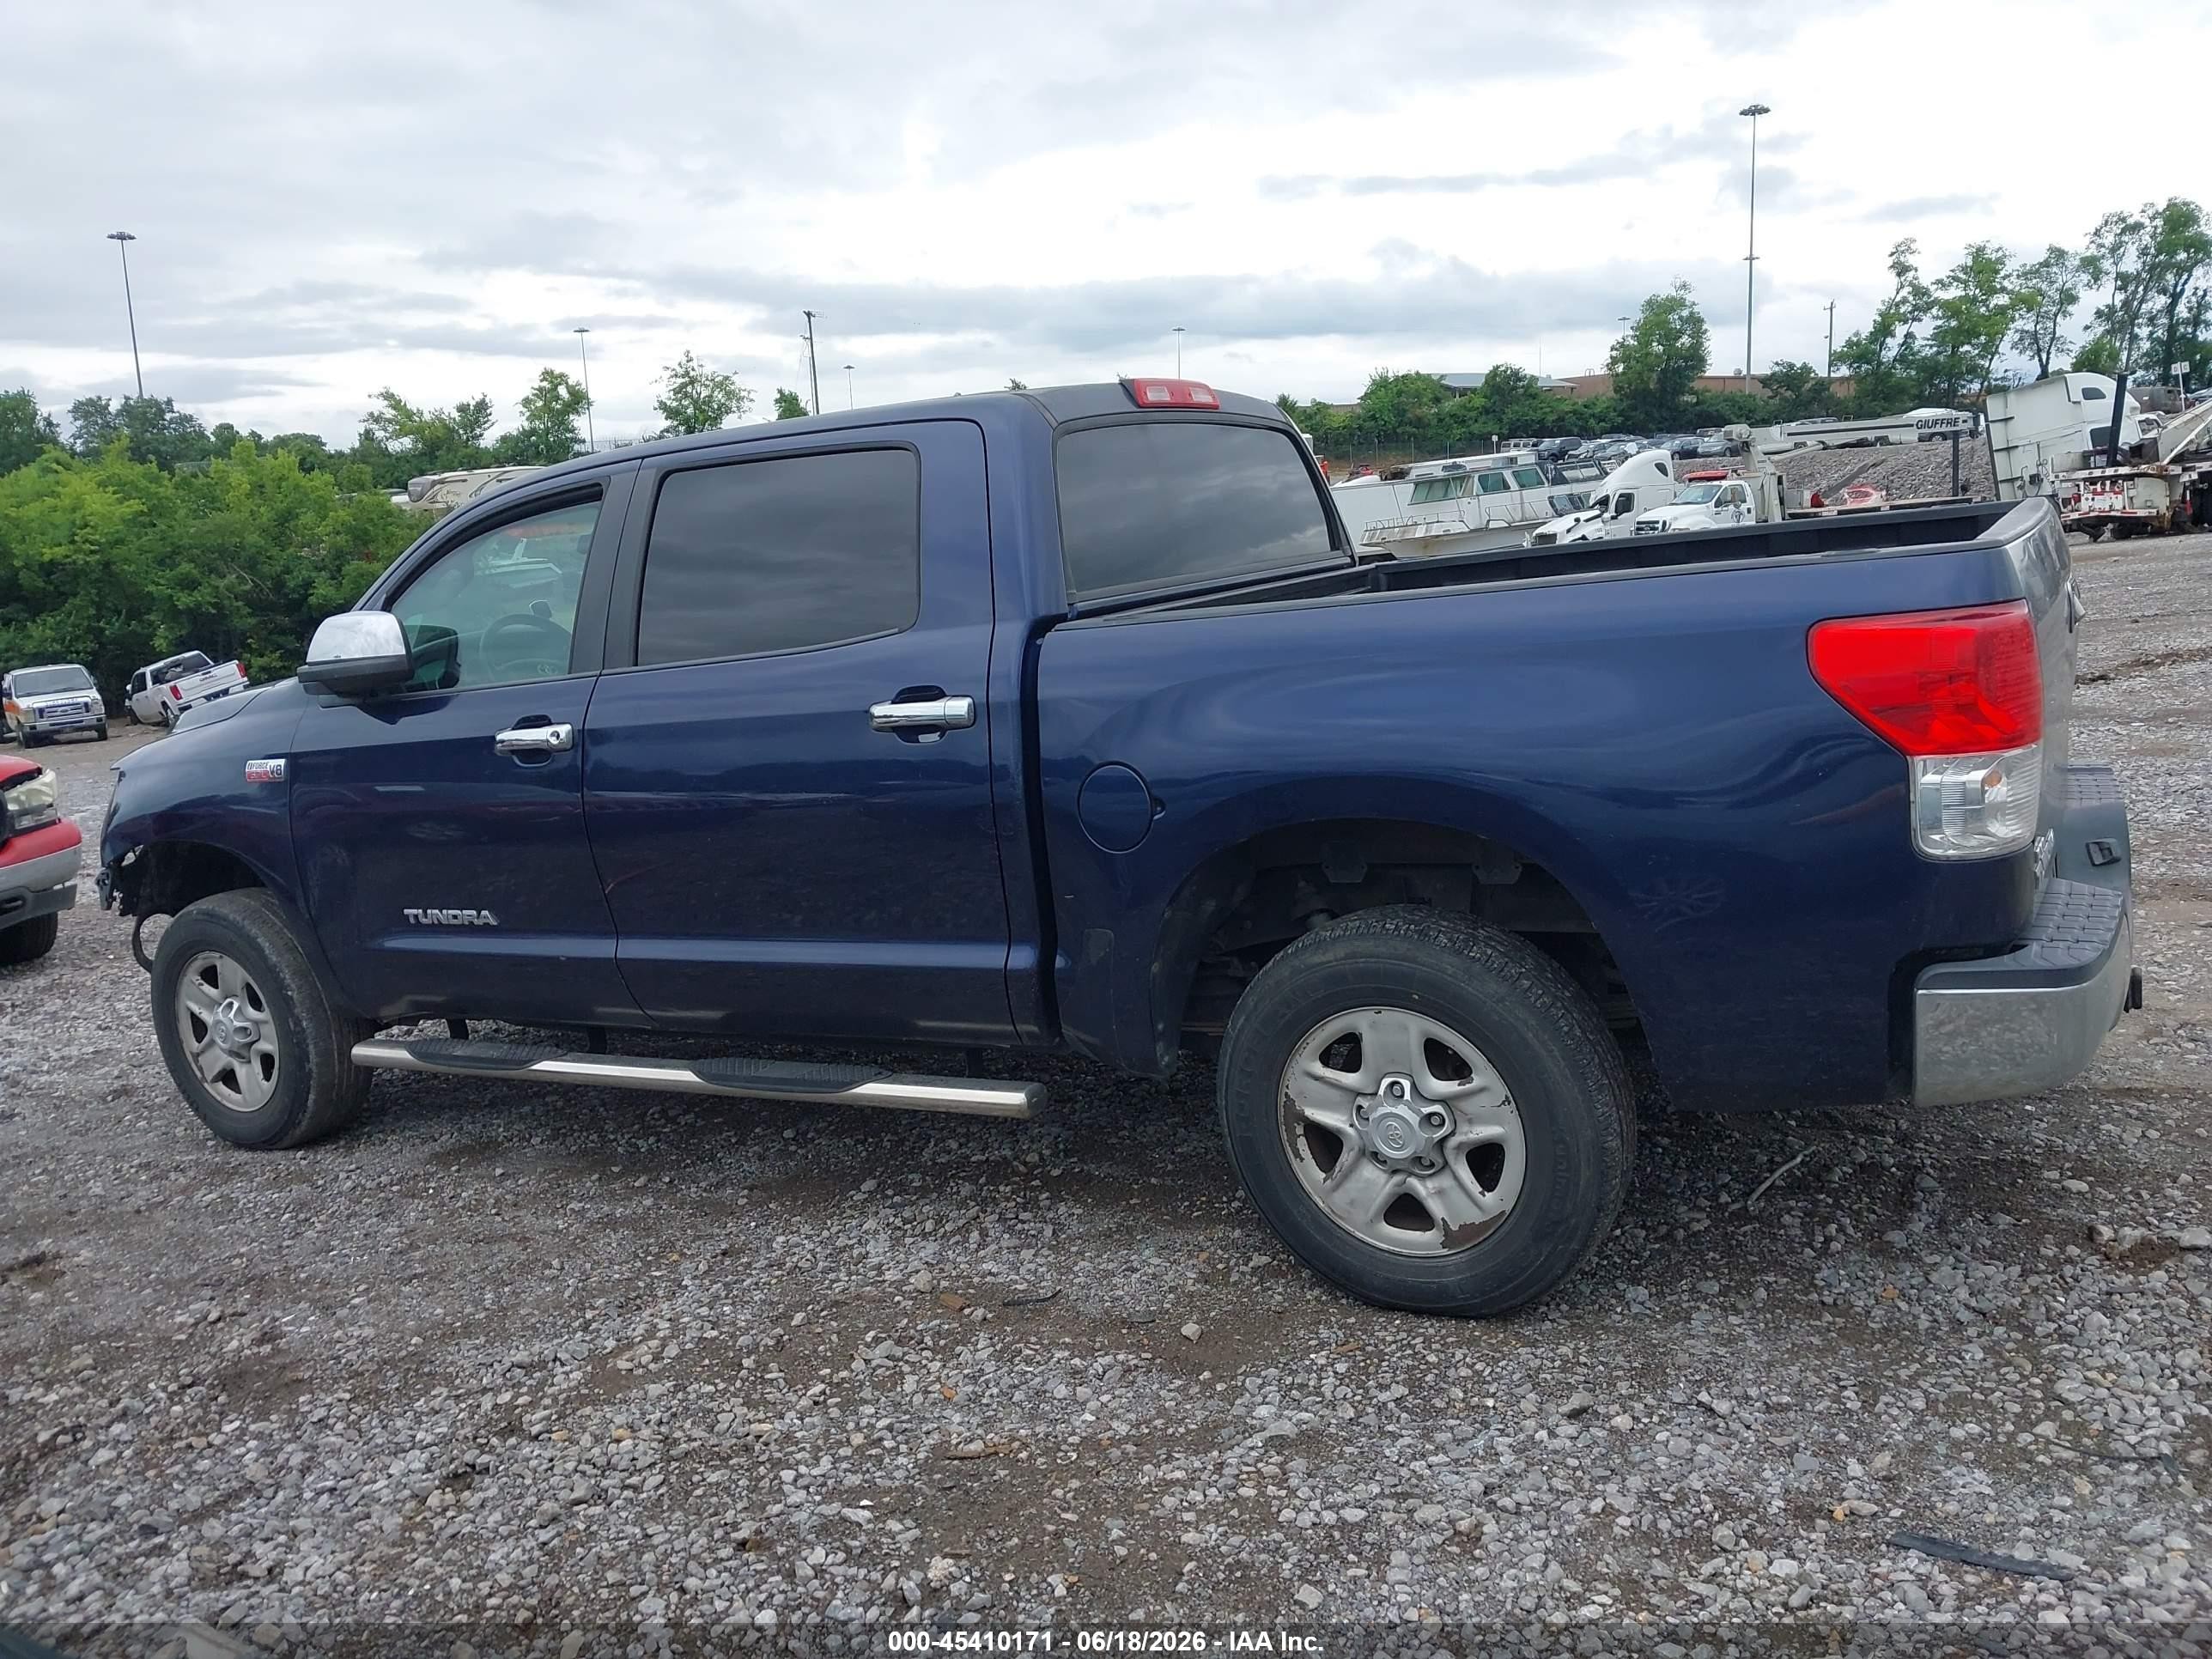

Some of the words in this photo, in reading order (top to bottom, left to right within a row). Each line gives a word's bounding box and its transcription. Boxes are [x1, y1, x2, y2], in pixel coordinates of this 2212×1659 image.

[1916, 417, 1960, 429] GIUFFRE
[269, 763, 283, 776] V8
[404, 908, 498, 926] TUNDRA
